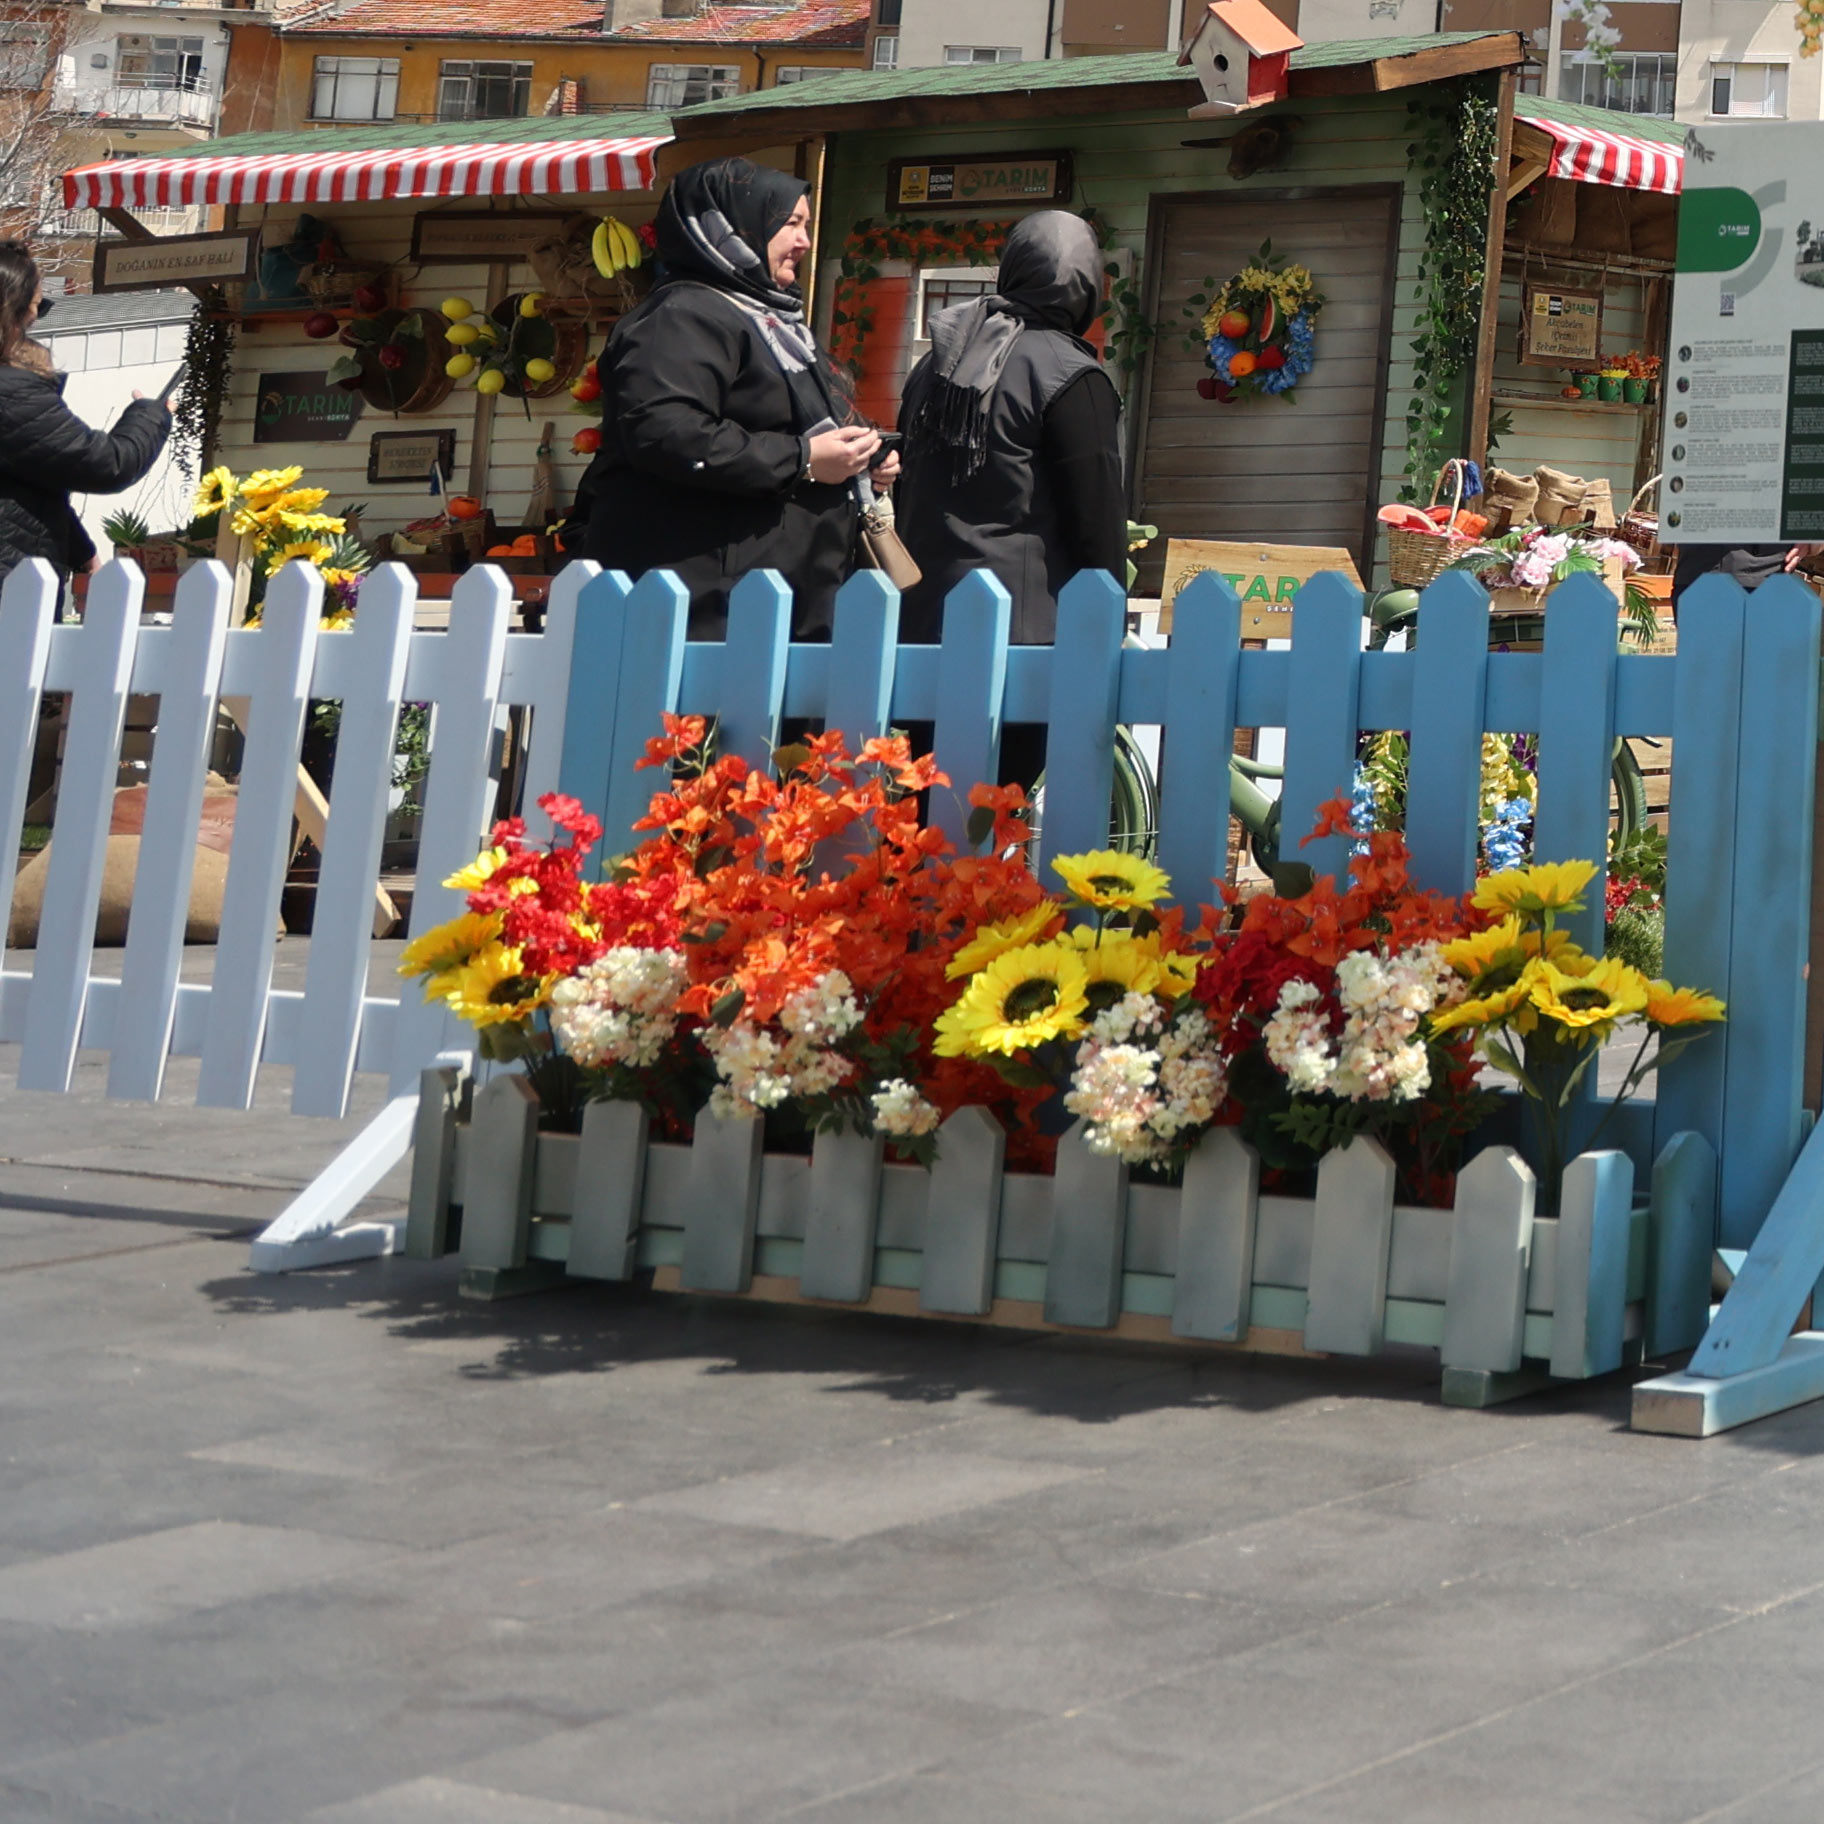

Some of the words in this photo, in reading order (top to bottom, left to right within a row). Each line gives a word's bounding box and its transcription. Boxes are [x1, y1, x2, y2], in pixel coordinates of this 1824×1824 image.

[983, 168, 1049, 187] TARIM
[116, 258, 164, 274] DOĞANIN
[286, 394, 353, 415] TARIM
